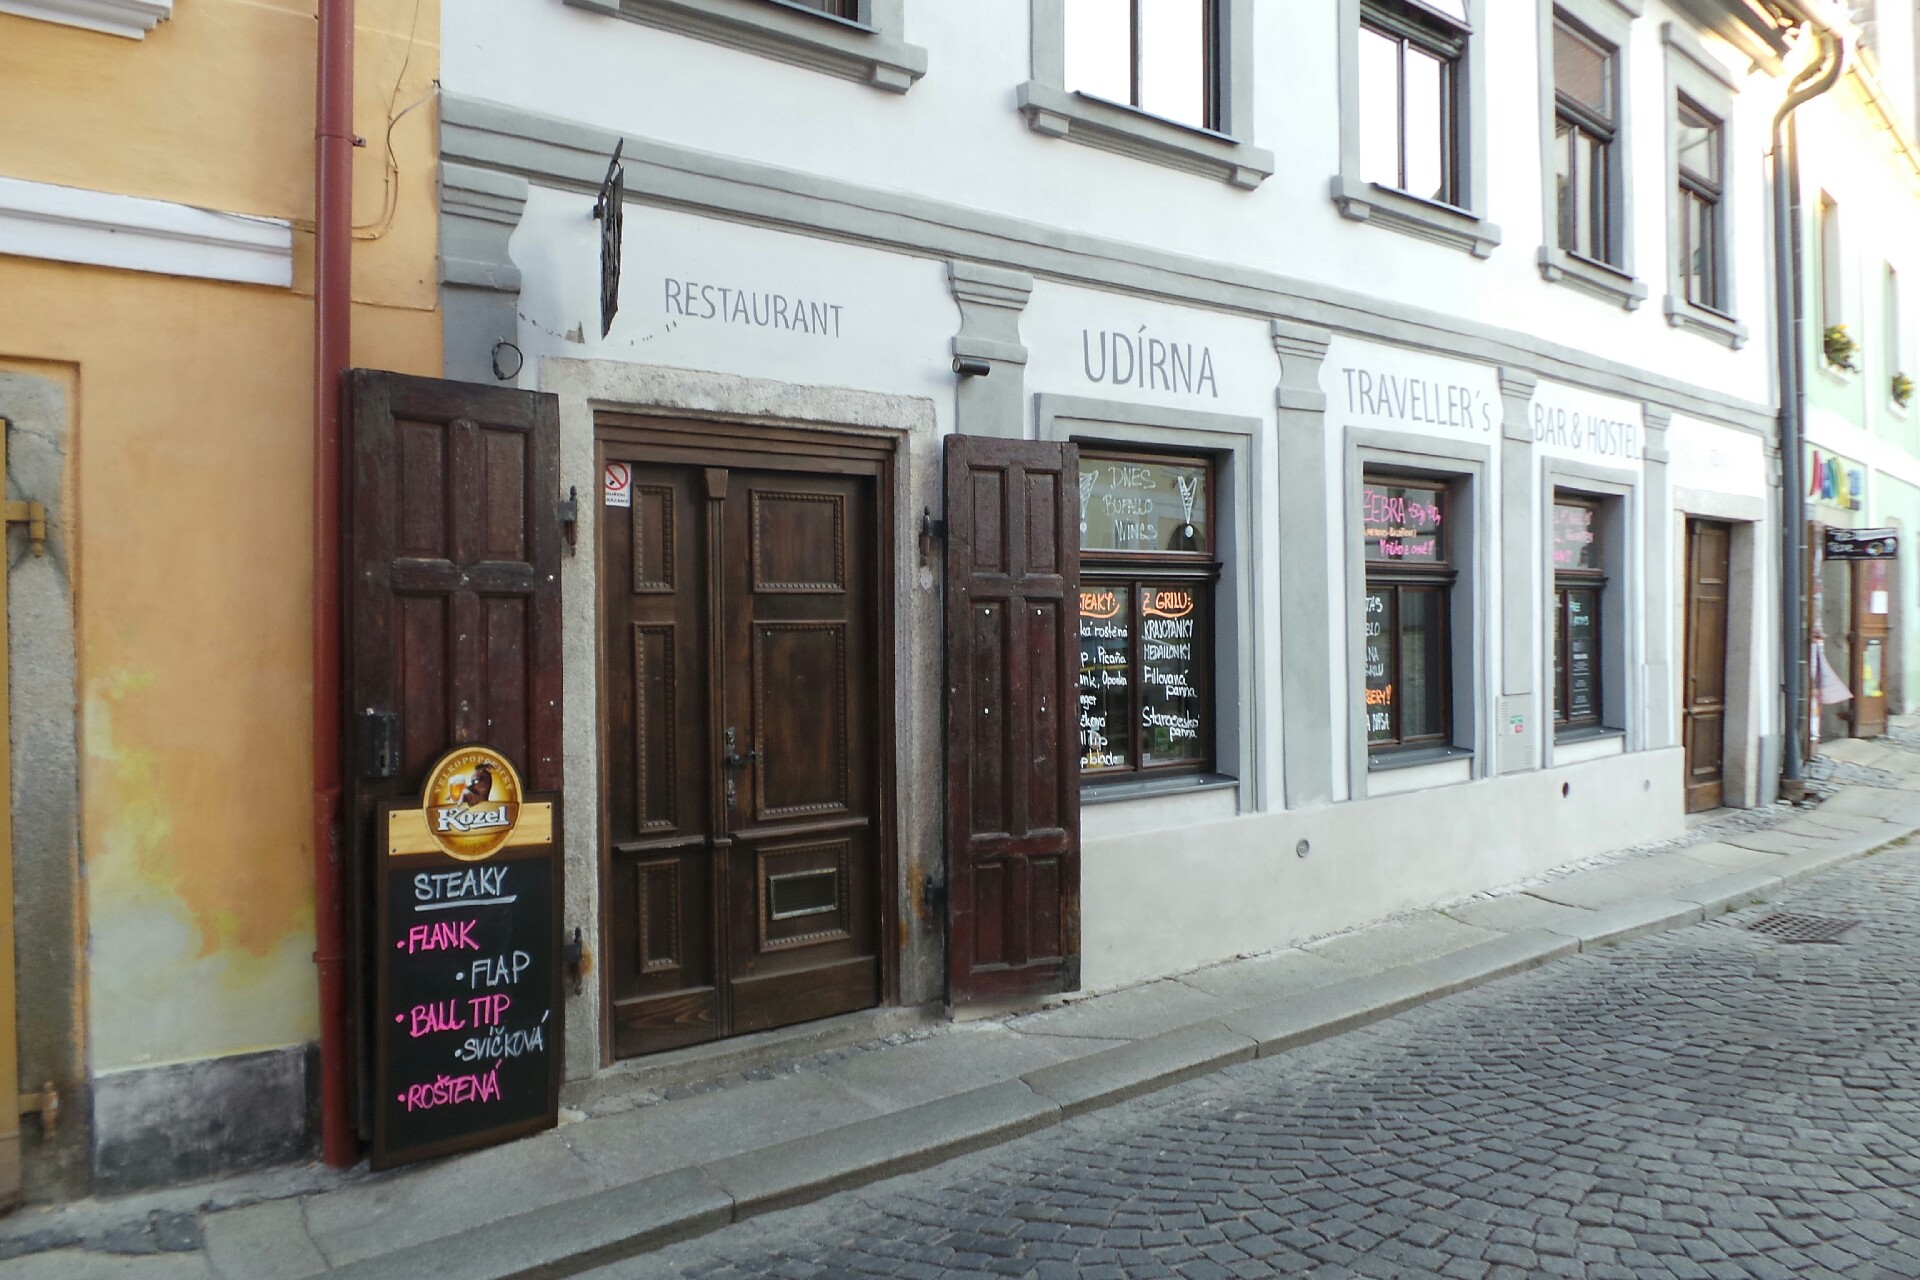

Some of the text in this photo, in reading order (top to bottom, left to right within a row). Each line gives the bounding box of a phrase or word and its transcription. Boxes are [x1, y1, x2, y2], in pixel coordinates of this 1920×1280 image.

[664, 277, 844, 338] RESTAURANT
[1083, 324, 1218, 398] UDÍRNA
[1534, 402, 1642, 461] BAR & HOSTEL
[1107, 466, 1156, 490] DNES
[1080, 591, 1116, 611] TEAKY:
[437, 805, 510, 832] Kozel
[414, 866, 508, 900] STEAKY
[407, 919, 480, 954] FLANK
[471, 950, 531, 990] FLAP
[468, 994, 511, 1029] TIP
